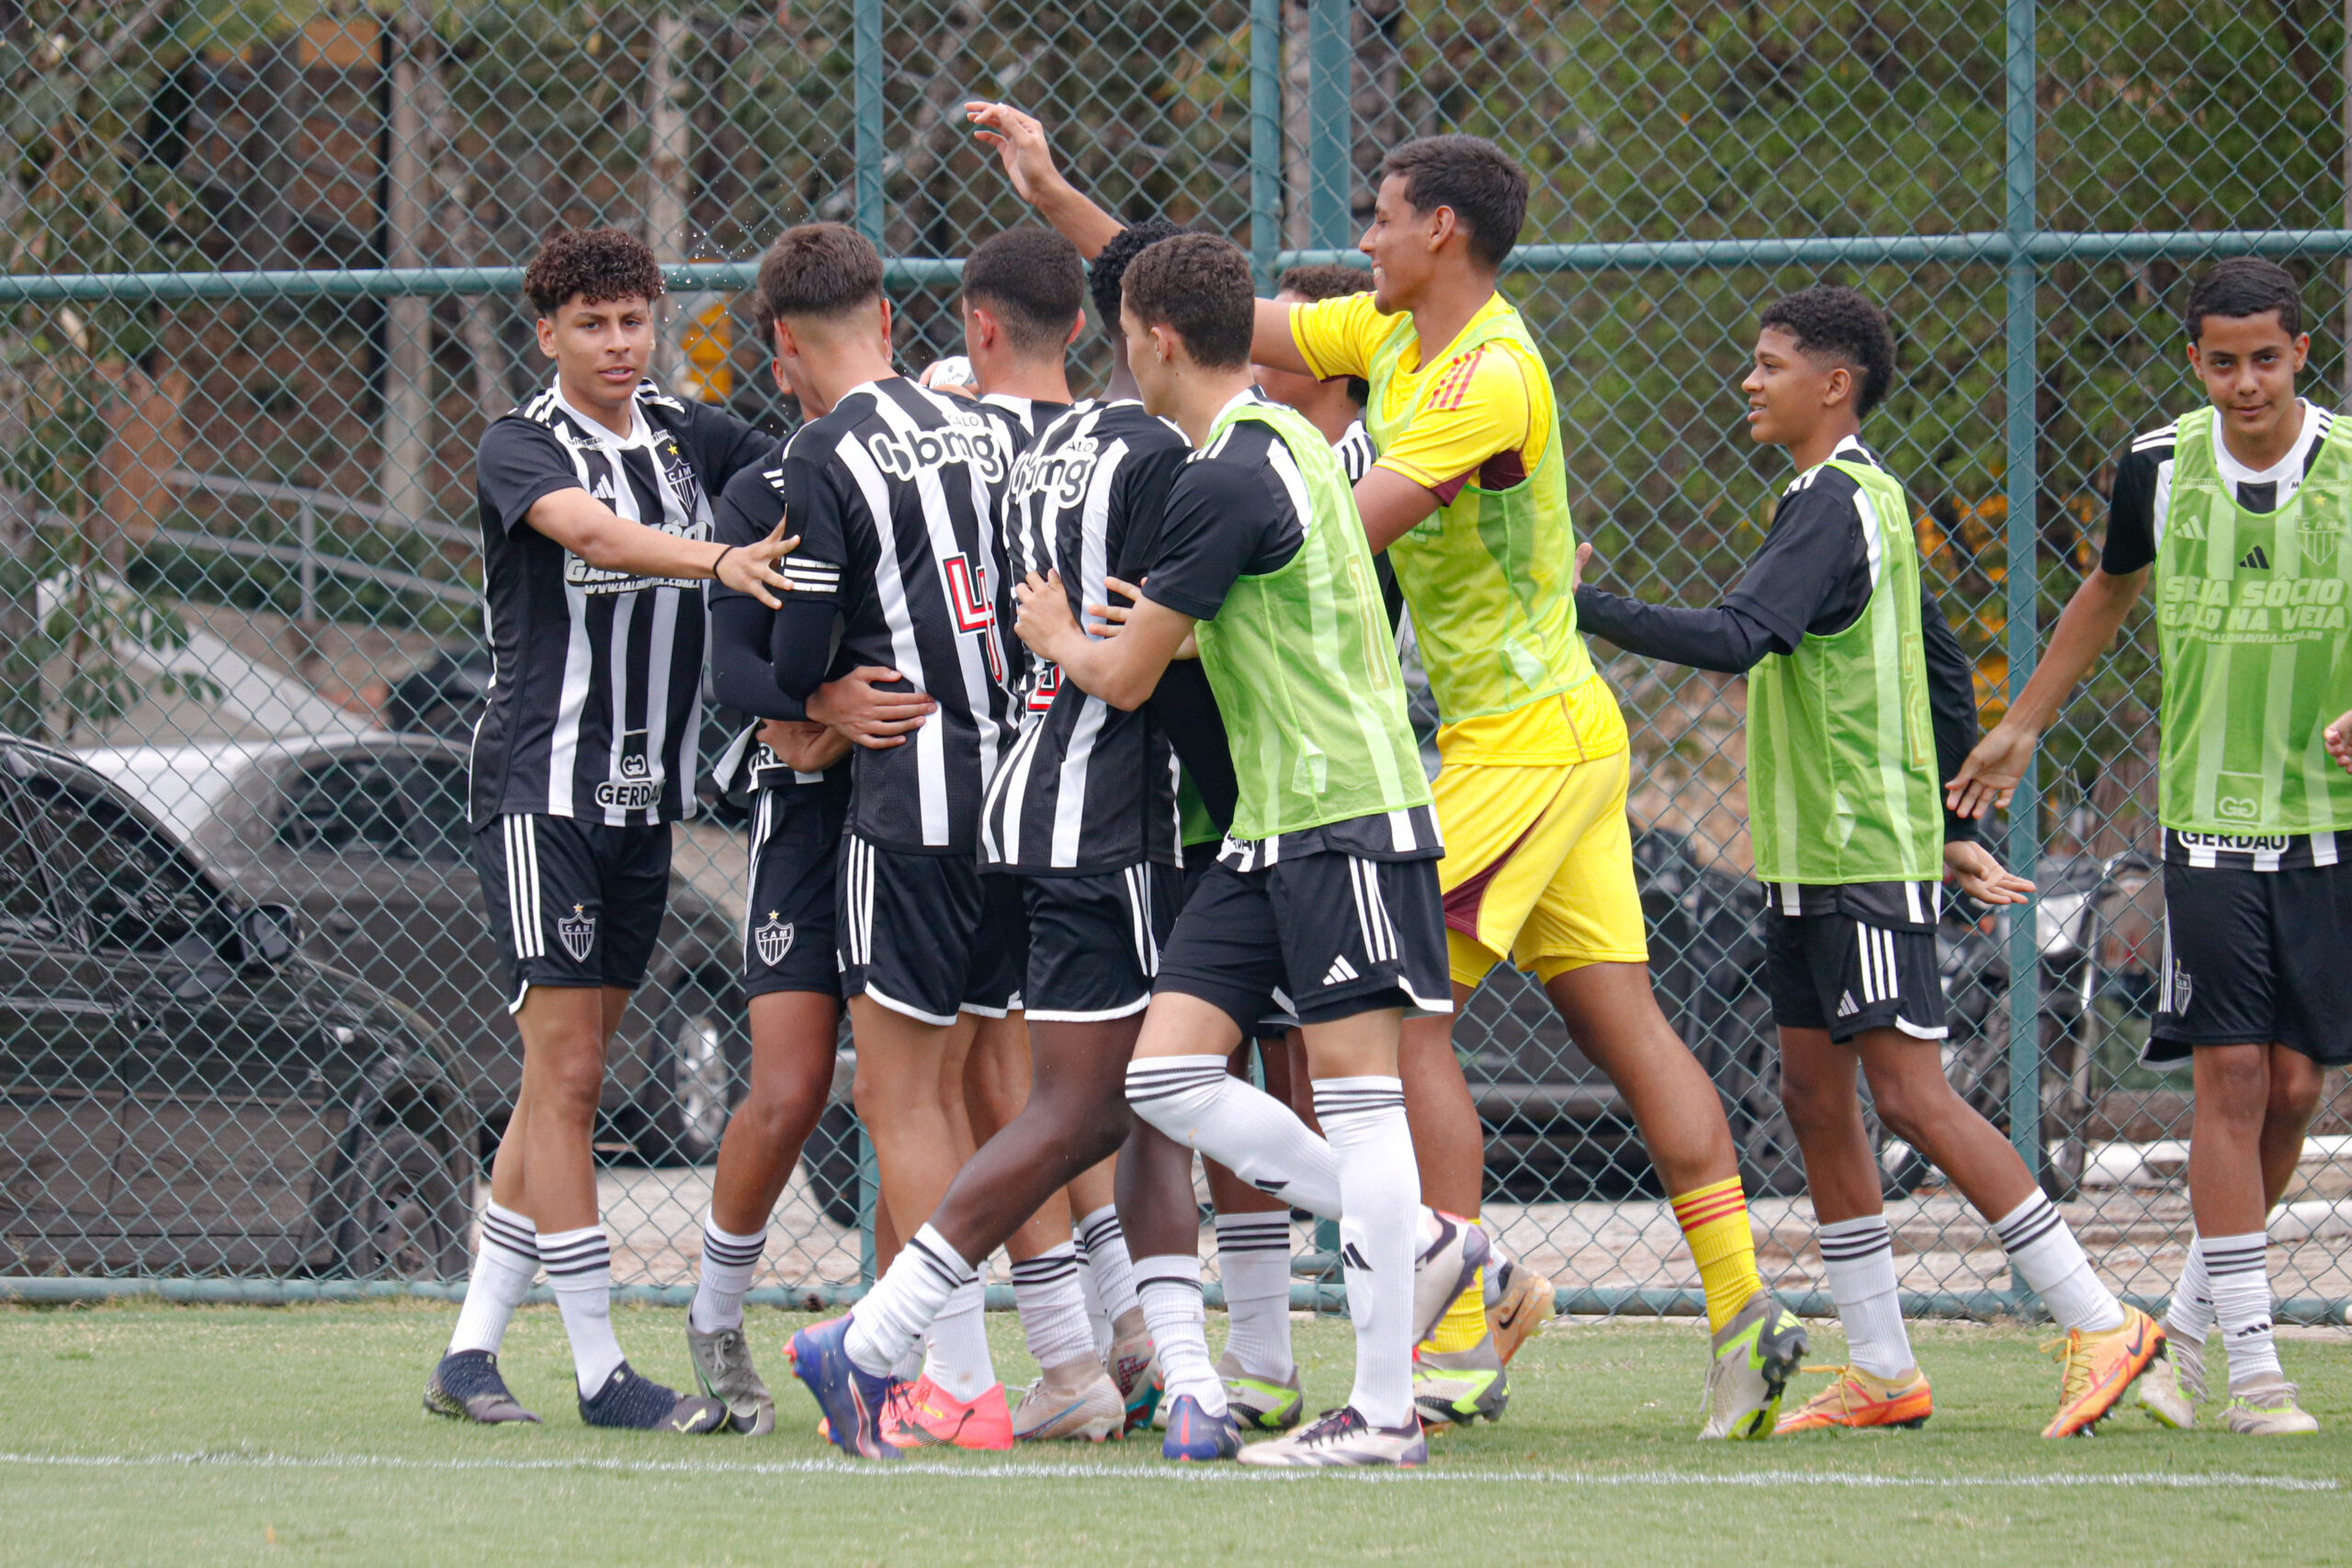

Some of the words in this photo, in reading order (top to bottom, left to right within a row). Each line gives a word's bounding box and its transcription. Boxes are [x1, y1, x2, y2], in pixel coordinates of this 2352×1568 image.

[905, 430, 999, 478] bmg
[1061, 441, 1093, 452] ALO
[668, 466, 692, 481] CAM
[2301, 521, 2338, 531] CAM
[943, 549, 1001, 683] 4
[2162, 604, 2222, 630] GALO
[2226, 608, 2268, 630] NA
[2282, 607, 2344, 629] VEIA
[2181, 830, 2285, 851] GERDAU
[565, 924, 591, 932] CAM
[762, 930, 787, 939] CAM
